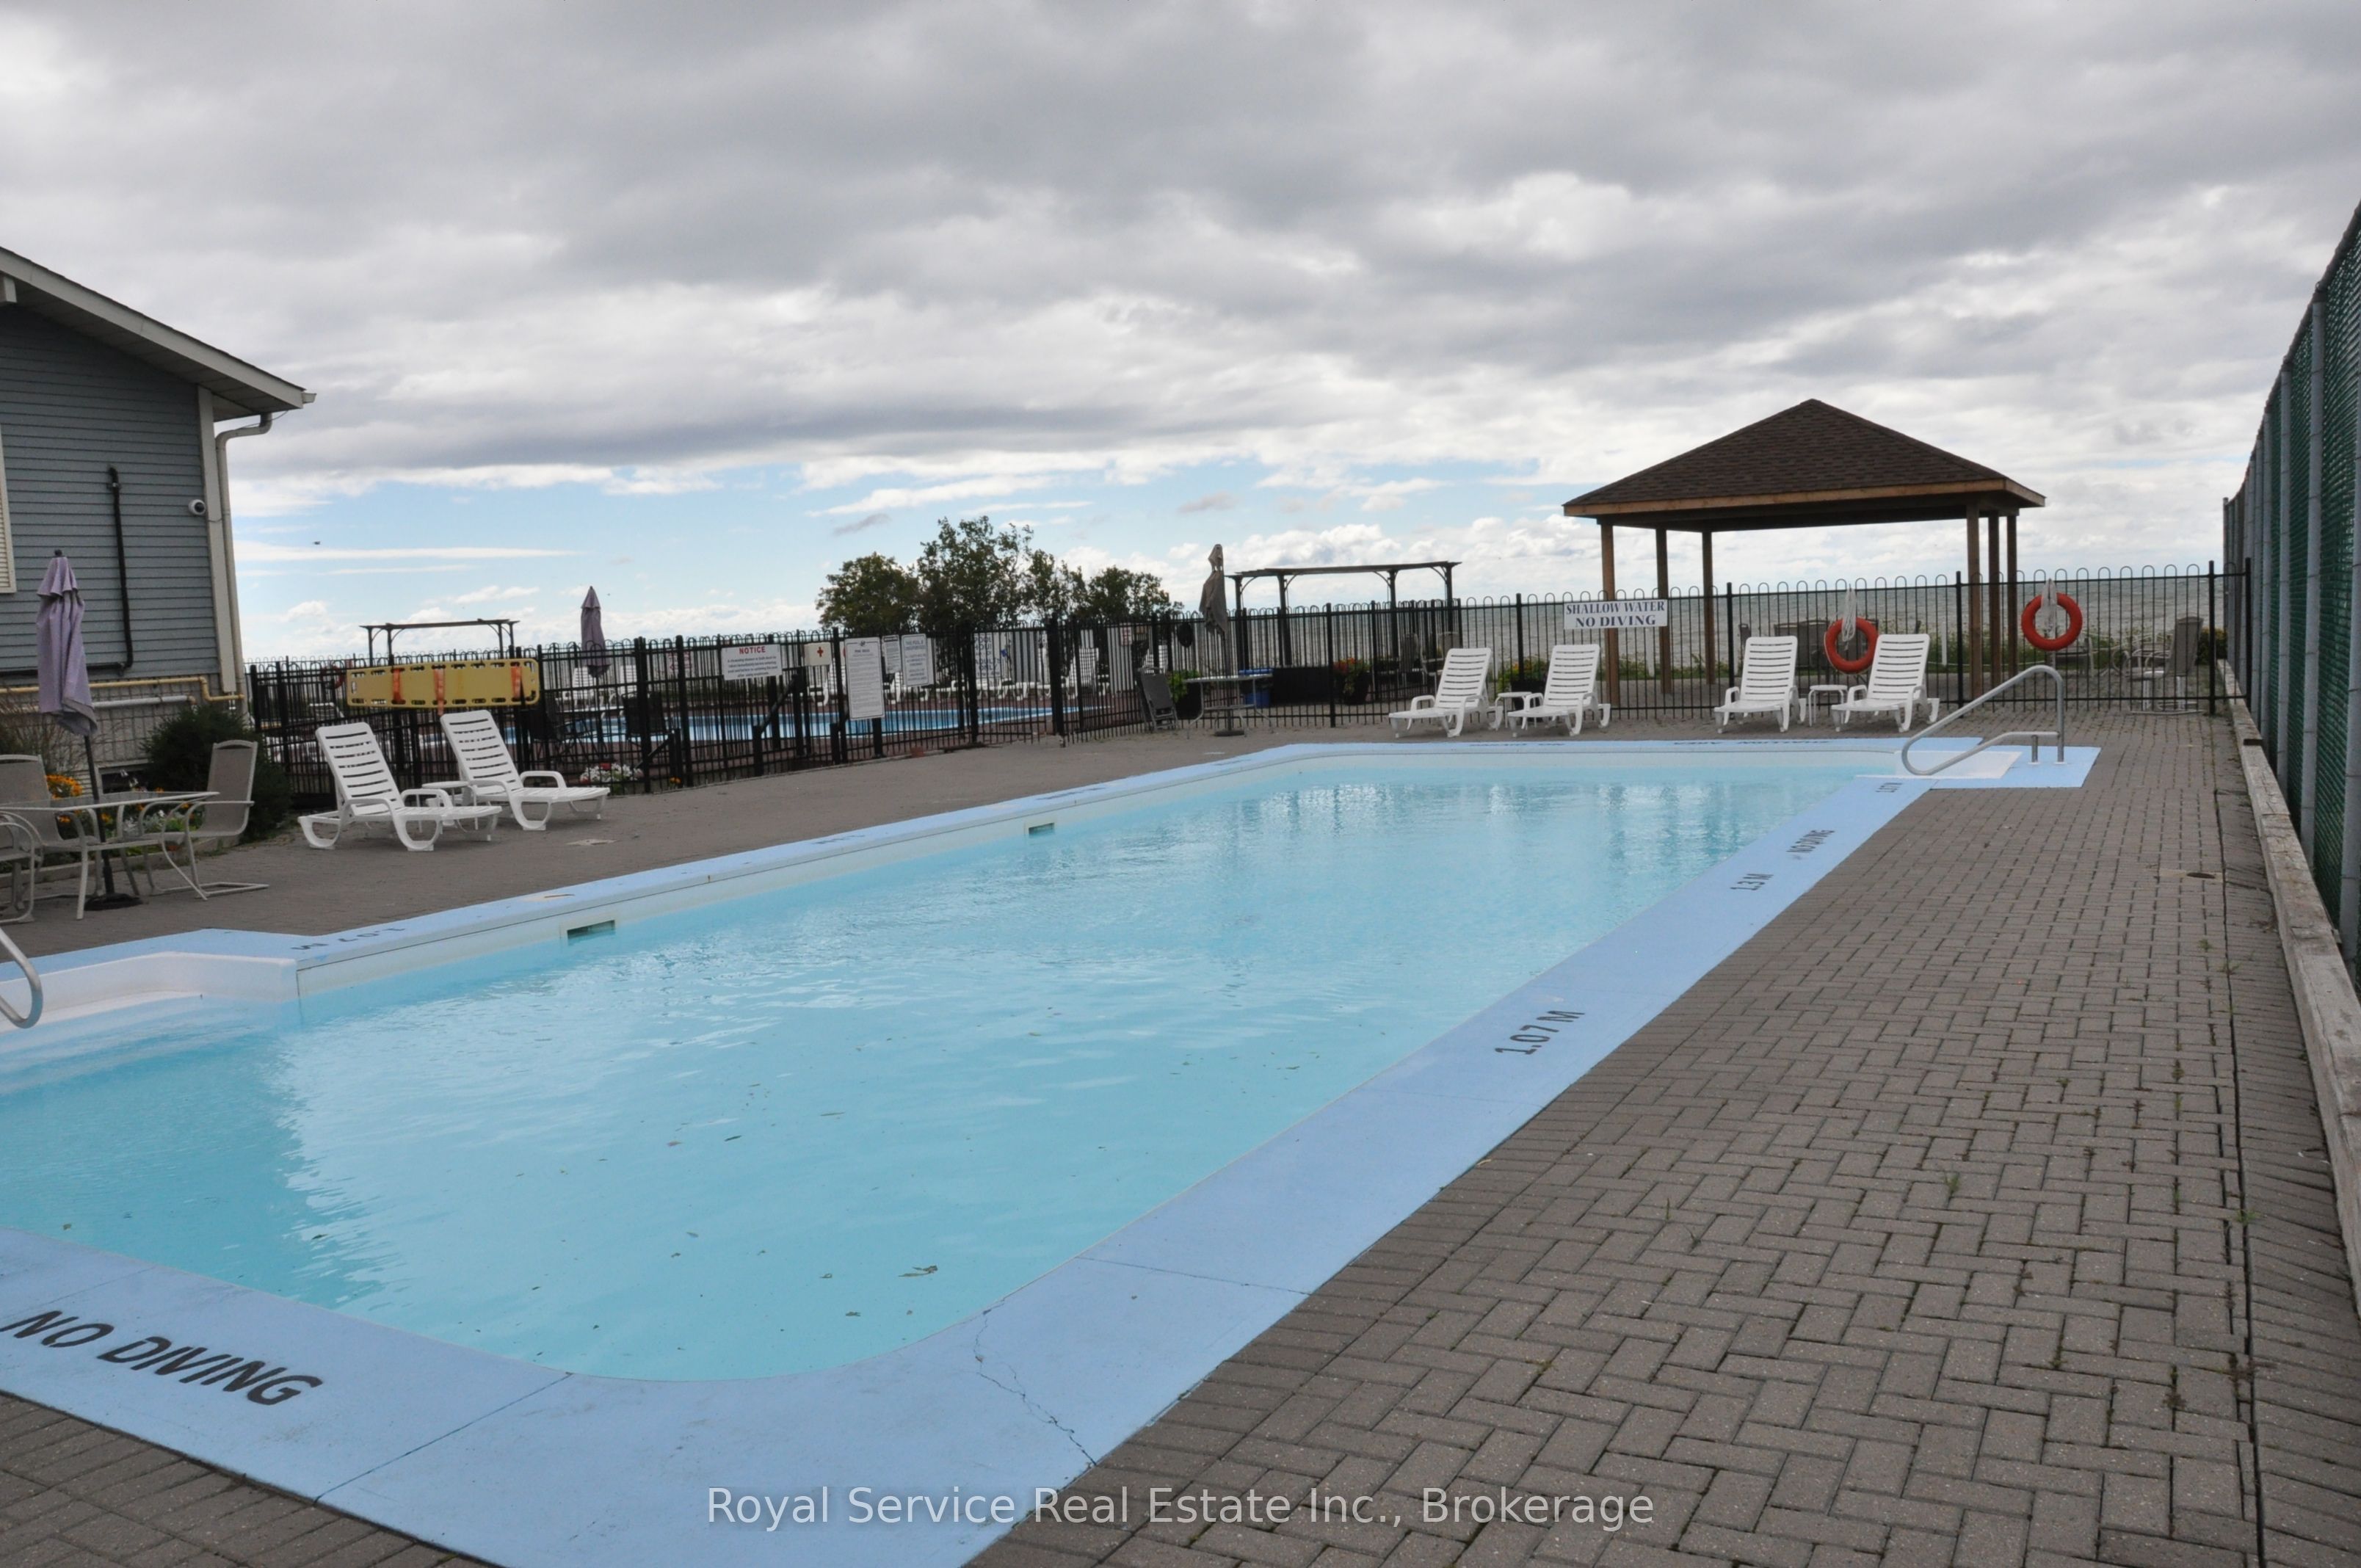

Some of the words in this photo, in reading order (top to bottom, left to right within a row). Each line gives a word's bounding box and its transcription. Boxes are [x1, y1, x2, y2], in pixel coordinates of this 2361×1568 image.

[1566, 603, 1620, 614] SHALLOW
[1625, 601, 1665, 612] WATER
[1575, 617, 1595, 628] NO
[1600, 614, 1656, 626] DIVING
[739, 646, 766, 655] NOTICE
[1795, 830, 1835, 845] DIVING
[1785, 845, 1816, 853] NO
[1494, 1024, 1560, 1055] 1.07
[1536, 1010, 1586, 1023] M
[0, 1310, 115, 1348] NO
[96, 1336, 323, 1406] DIVING
